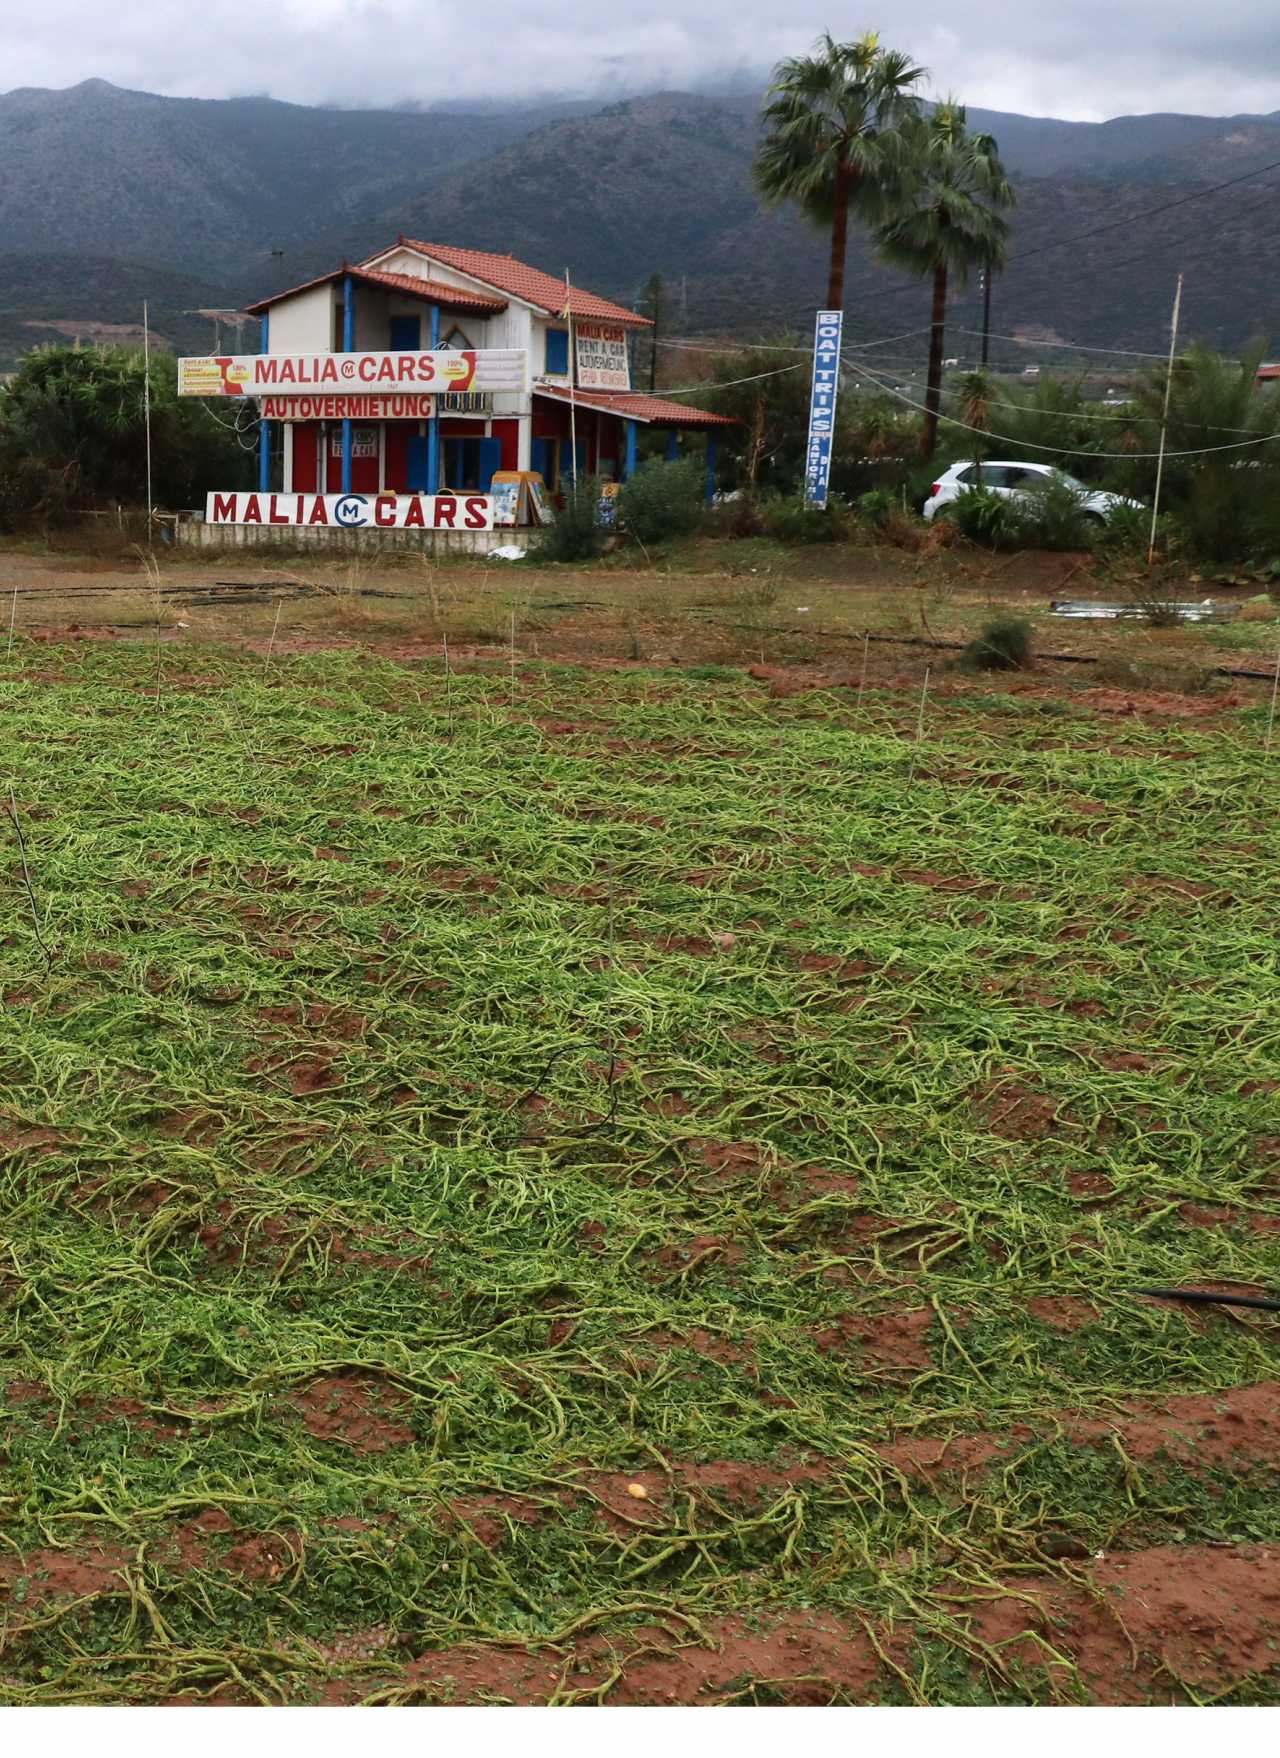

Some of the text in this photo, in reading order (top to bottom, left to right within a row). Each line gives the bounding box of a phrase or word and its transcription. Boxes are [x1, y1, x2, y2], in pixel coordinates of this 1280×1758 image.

[579, 340, 599, 353] RENT
[818, 314, 838, 363] BOAT
[255, 357, 338, 384] MALIA
[358, 355, 436, 382] CARS
[263, 394, 431, 417] AUTOVERMIETUNG
[812, 370, 835, 430] TRIPS
[213, 494, 328, 525] MALIA
[375, 496, 488, 529] CARS
